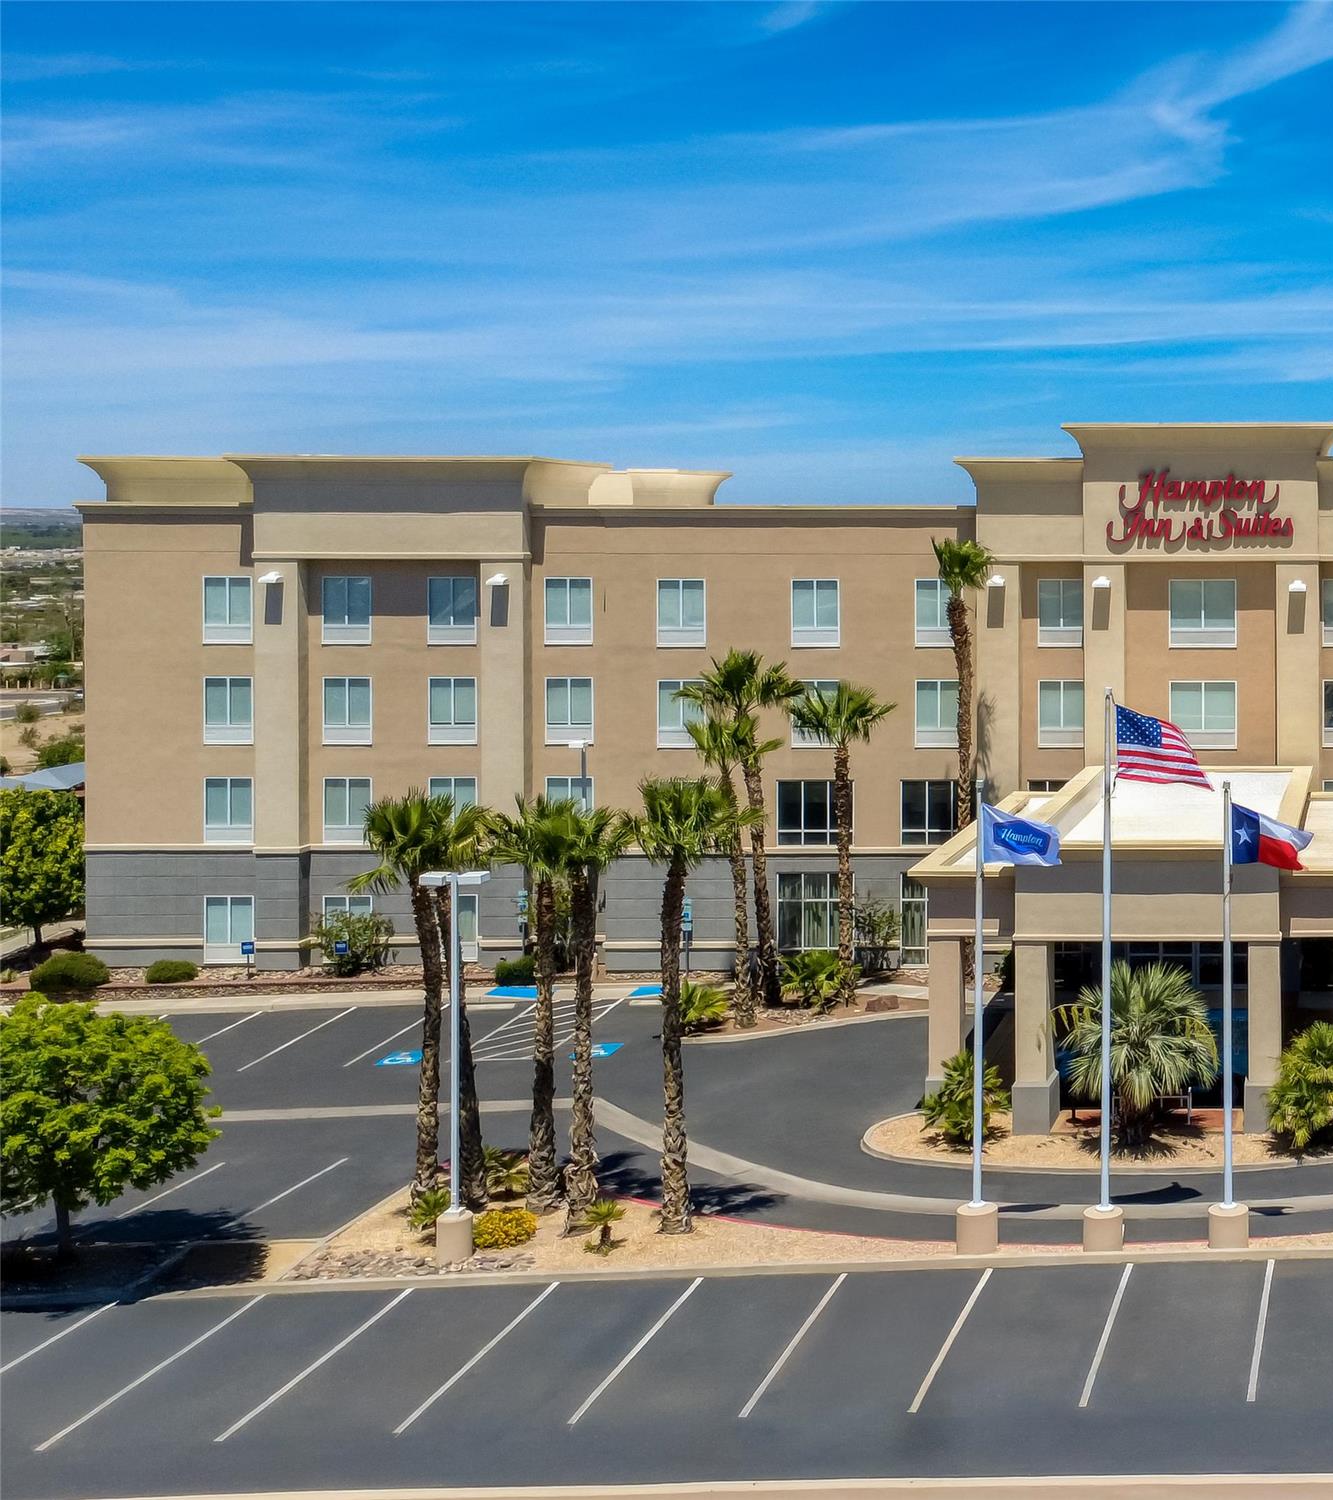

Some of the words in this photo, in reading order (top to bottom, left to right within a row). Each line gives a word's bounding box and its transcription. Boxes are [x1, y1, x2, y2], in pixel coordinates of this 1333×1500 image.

[1119, 470, 1279, 509] Hampton
[1106, 511, 1186, 542] Inn
[1187, 517, 1208, 541] &
[1207, 509, 1294, 539] Suites
[1001, 828, 1043, 847] Hampton
